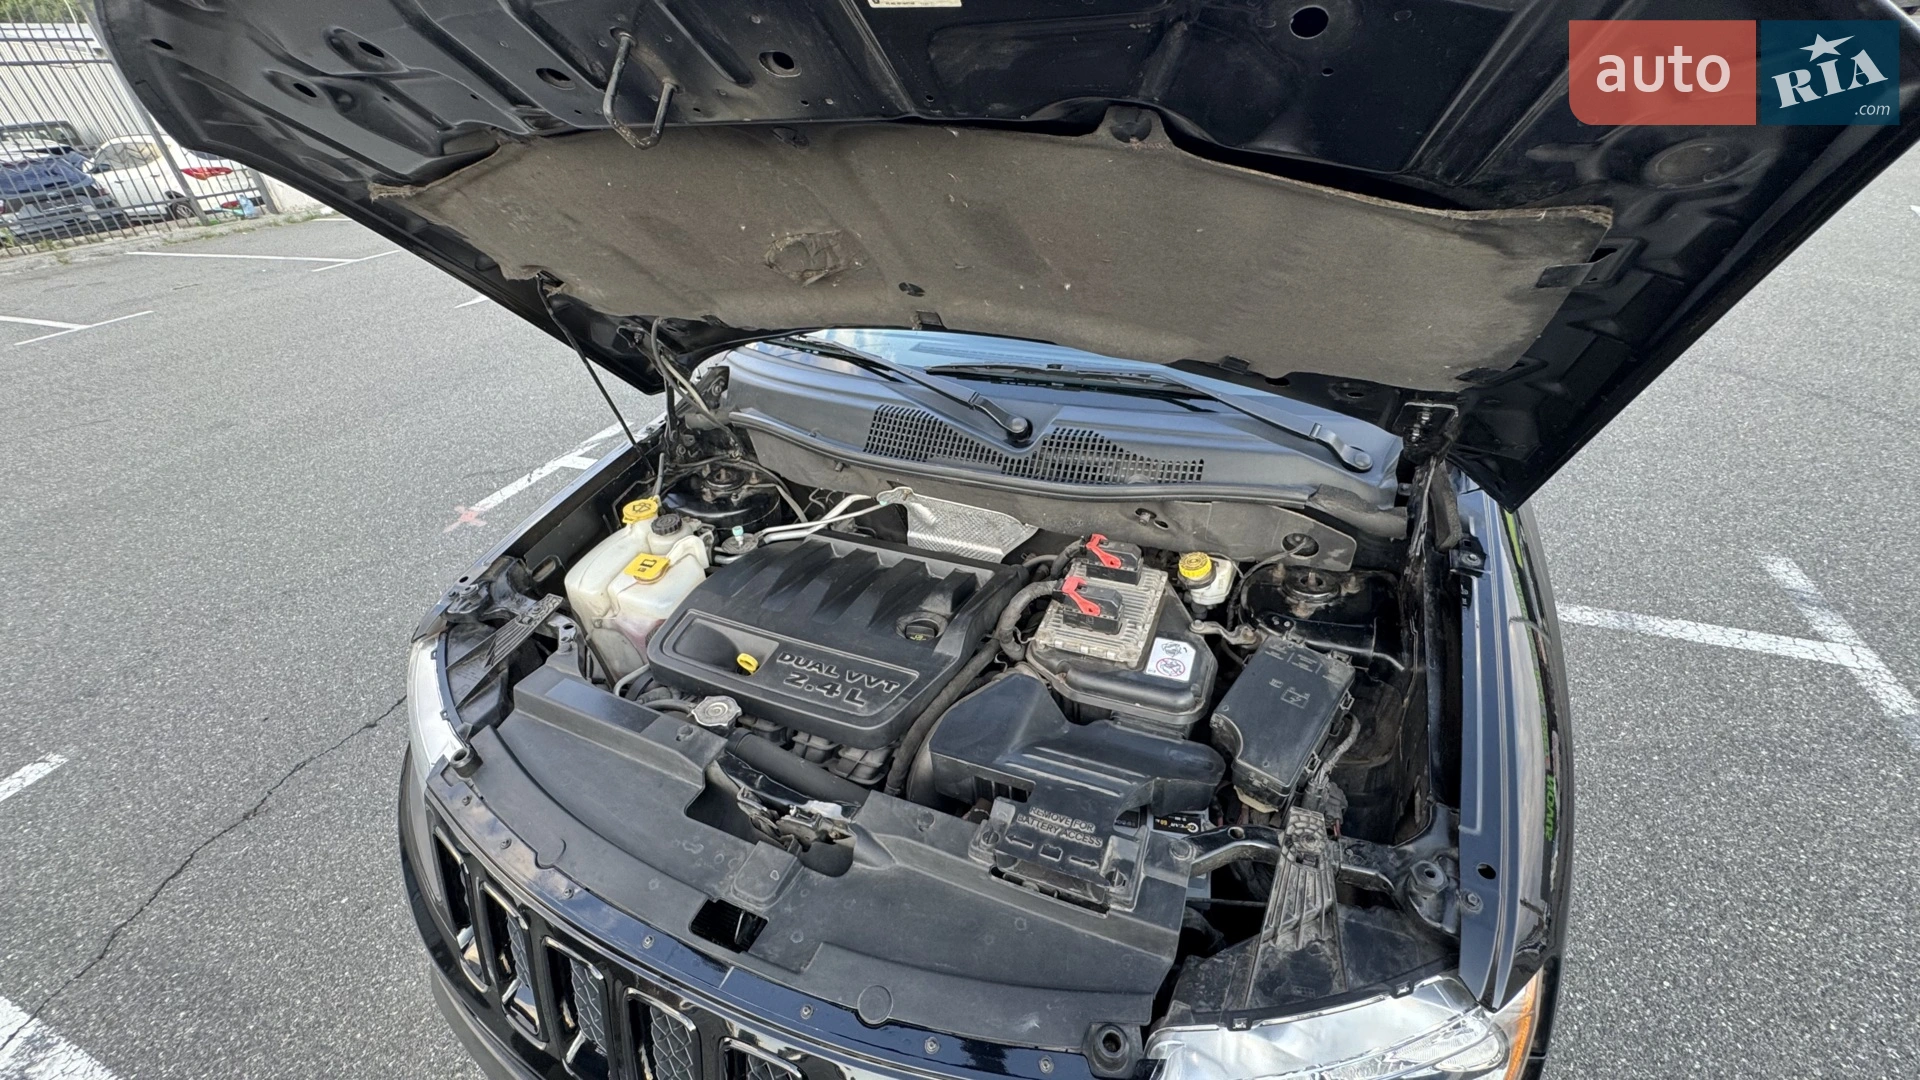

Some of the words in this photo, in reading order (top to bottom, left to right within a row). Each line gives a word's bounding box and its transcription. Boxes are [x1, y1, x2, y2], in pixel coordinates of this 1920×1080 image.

[776, 651, 840, 678] DUAL
[845, 669, 900, 693] VVT
[1016, 813, 1062, 836] BATTERY
[1060, 828, 1104, 848] ACCESS
[1029, 806, 1073, 827] REMOVE
[1071, 818, 1097, 833] FOR
